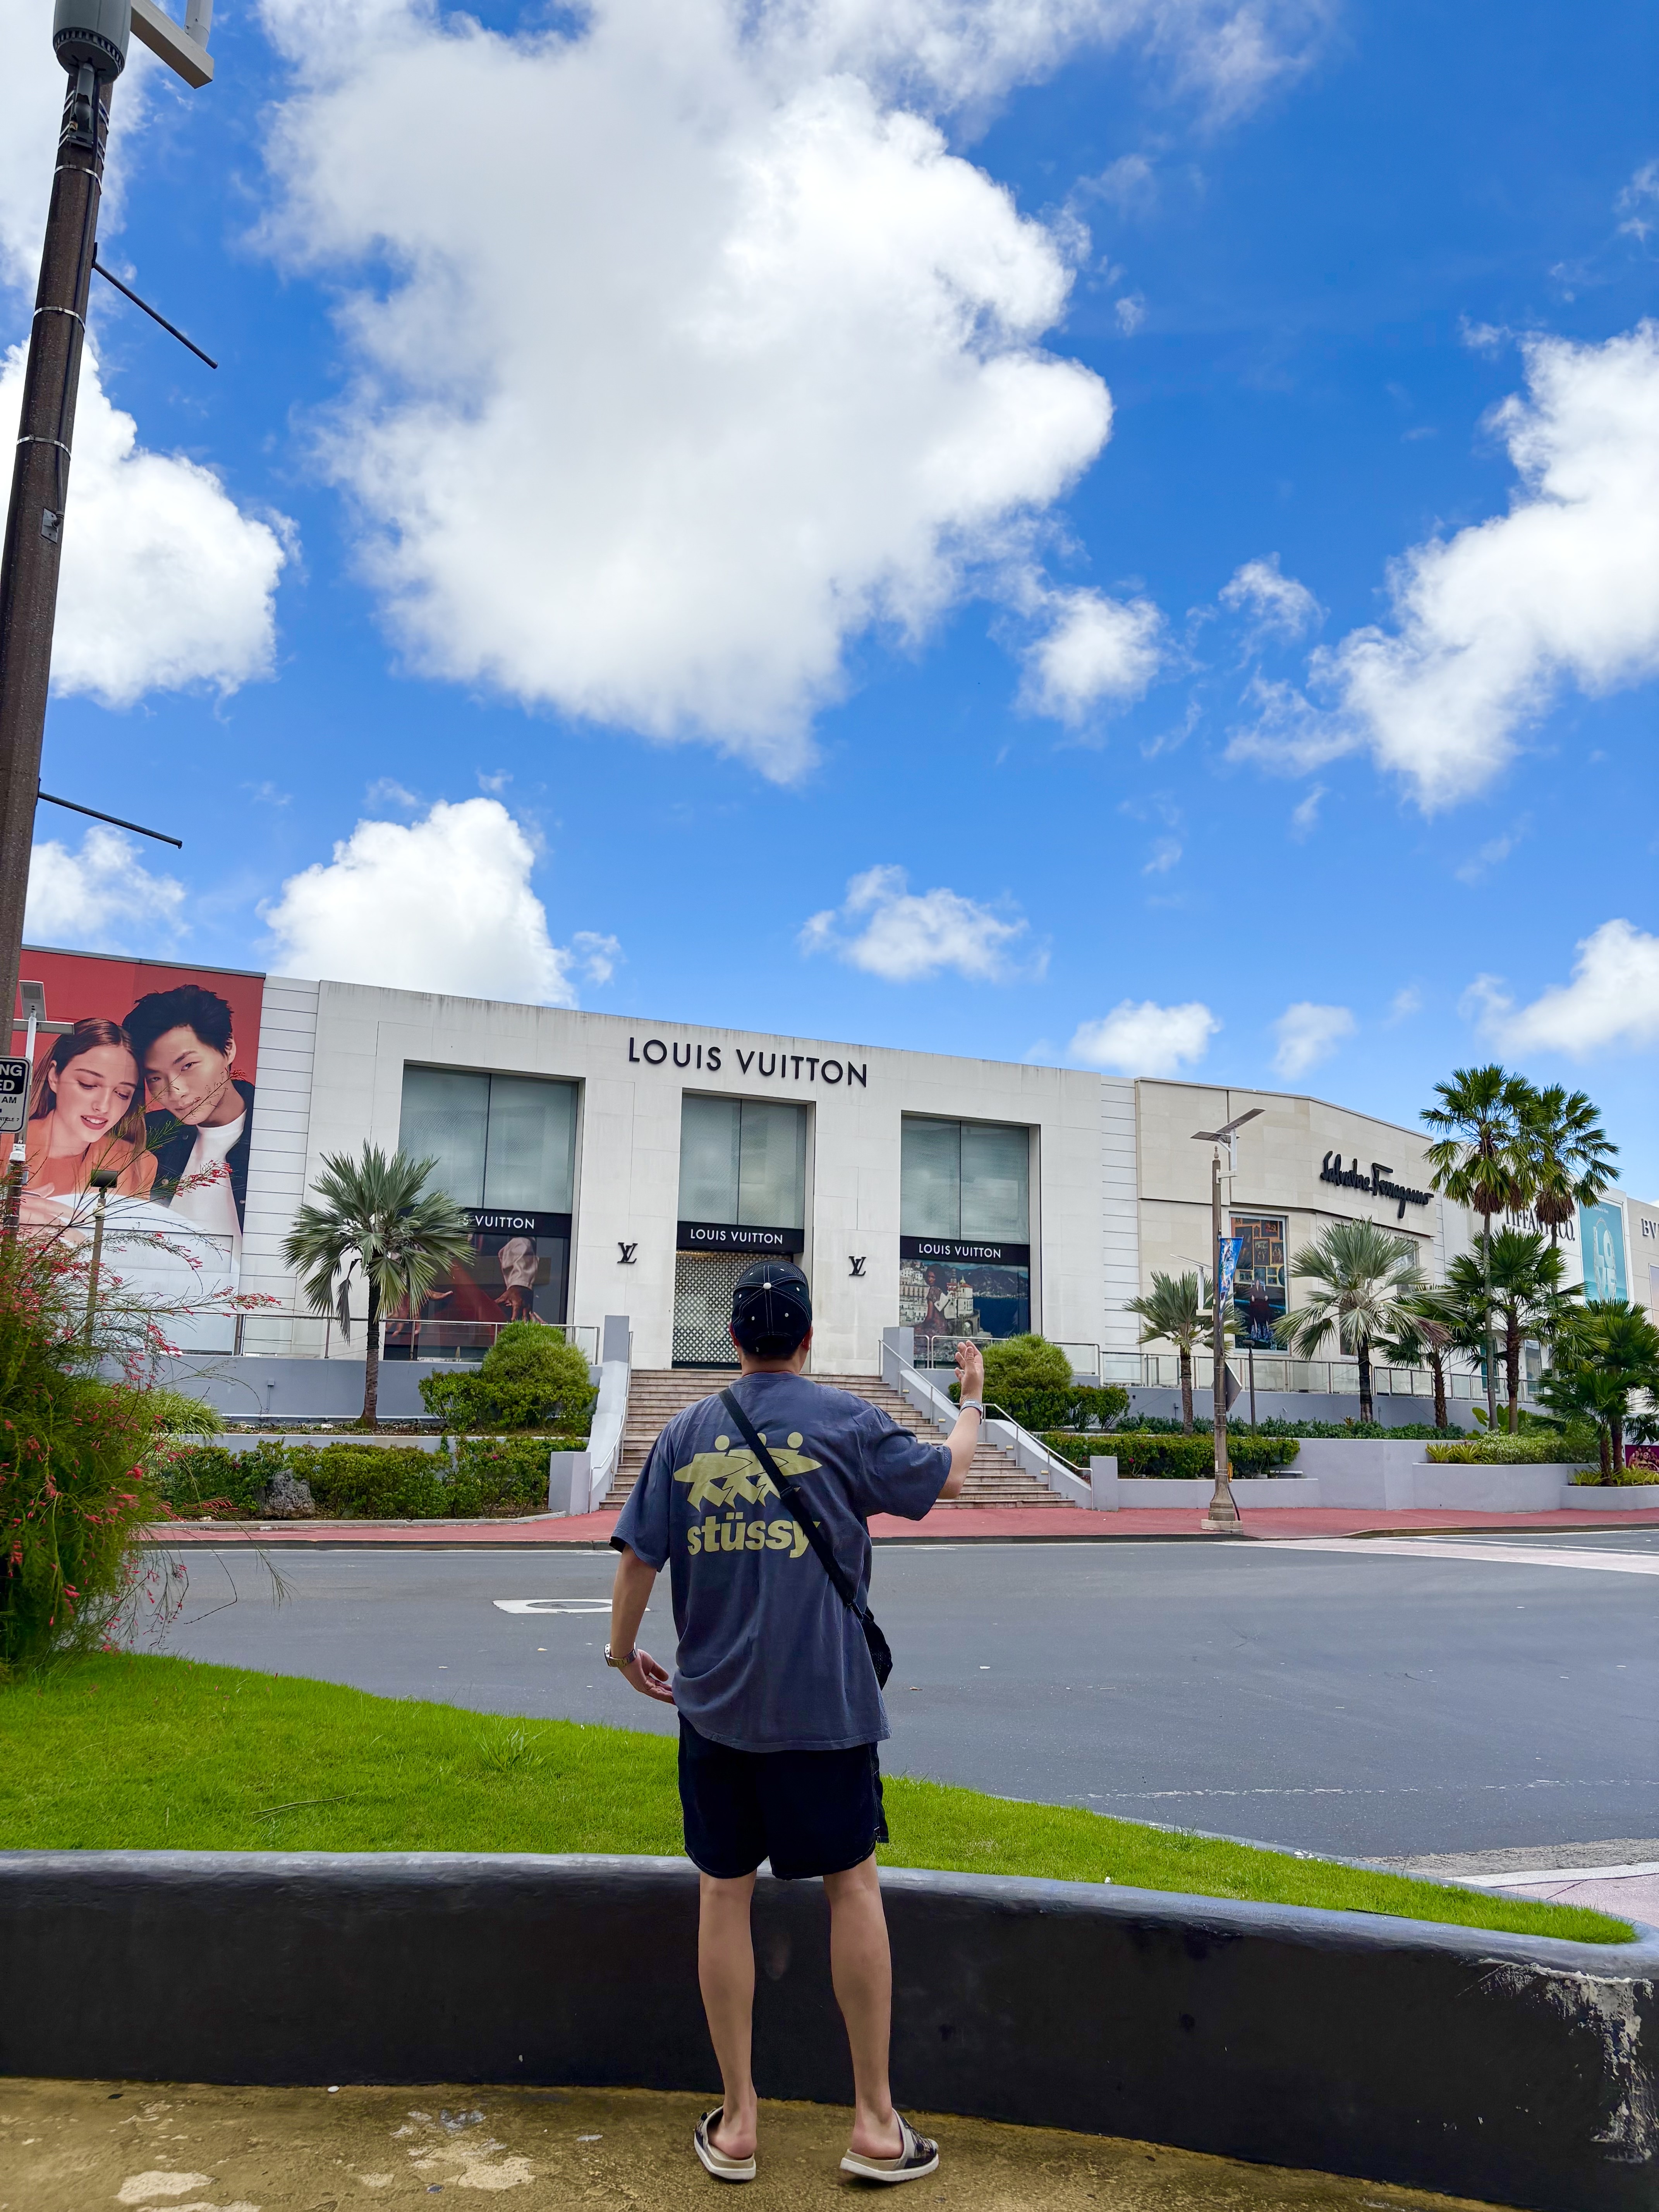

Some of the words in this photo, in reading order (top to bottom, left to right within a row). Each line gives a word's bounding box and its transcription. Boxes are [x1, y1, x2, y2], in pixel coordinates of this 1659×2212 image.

[629, 1037, 721, 1071] LOUIS
[736, 1049, 867, 1088] VUITTON
[475, 1215, 534, 1229] VUITTON
[690, 1229, 726, 1241] LOUIS
[731, 1231, 783, 1244] VUITTON
[919, 1243, 951, 1255] LOUIS
[955, 1246, 1001, 1259] VUITTON
[687, 1511, 821, 1559] stüssy
